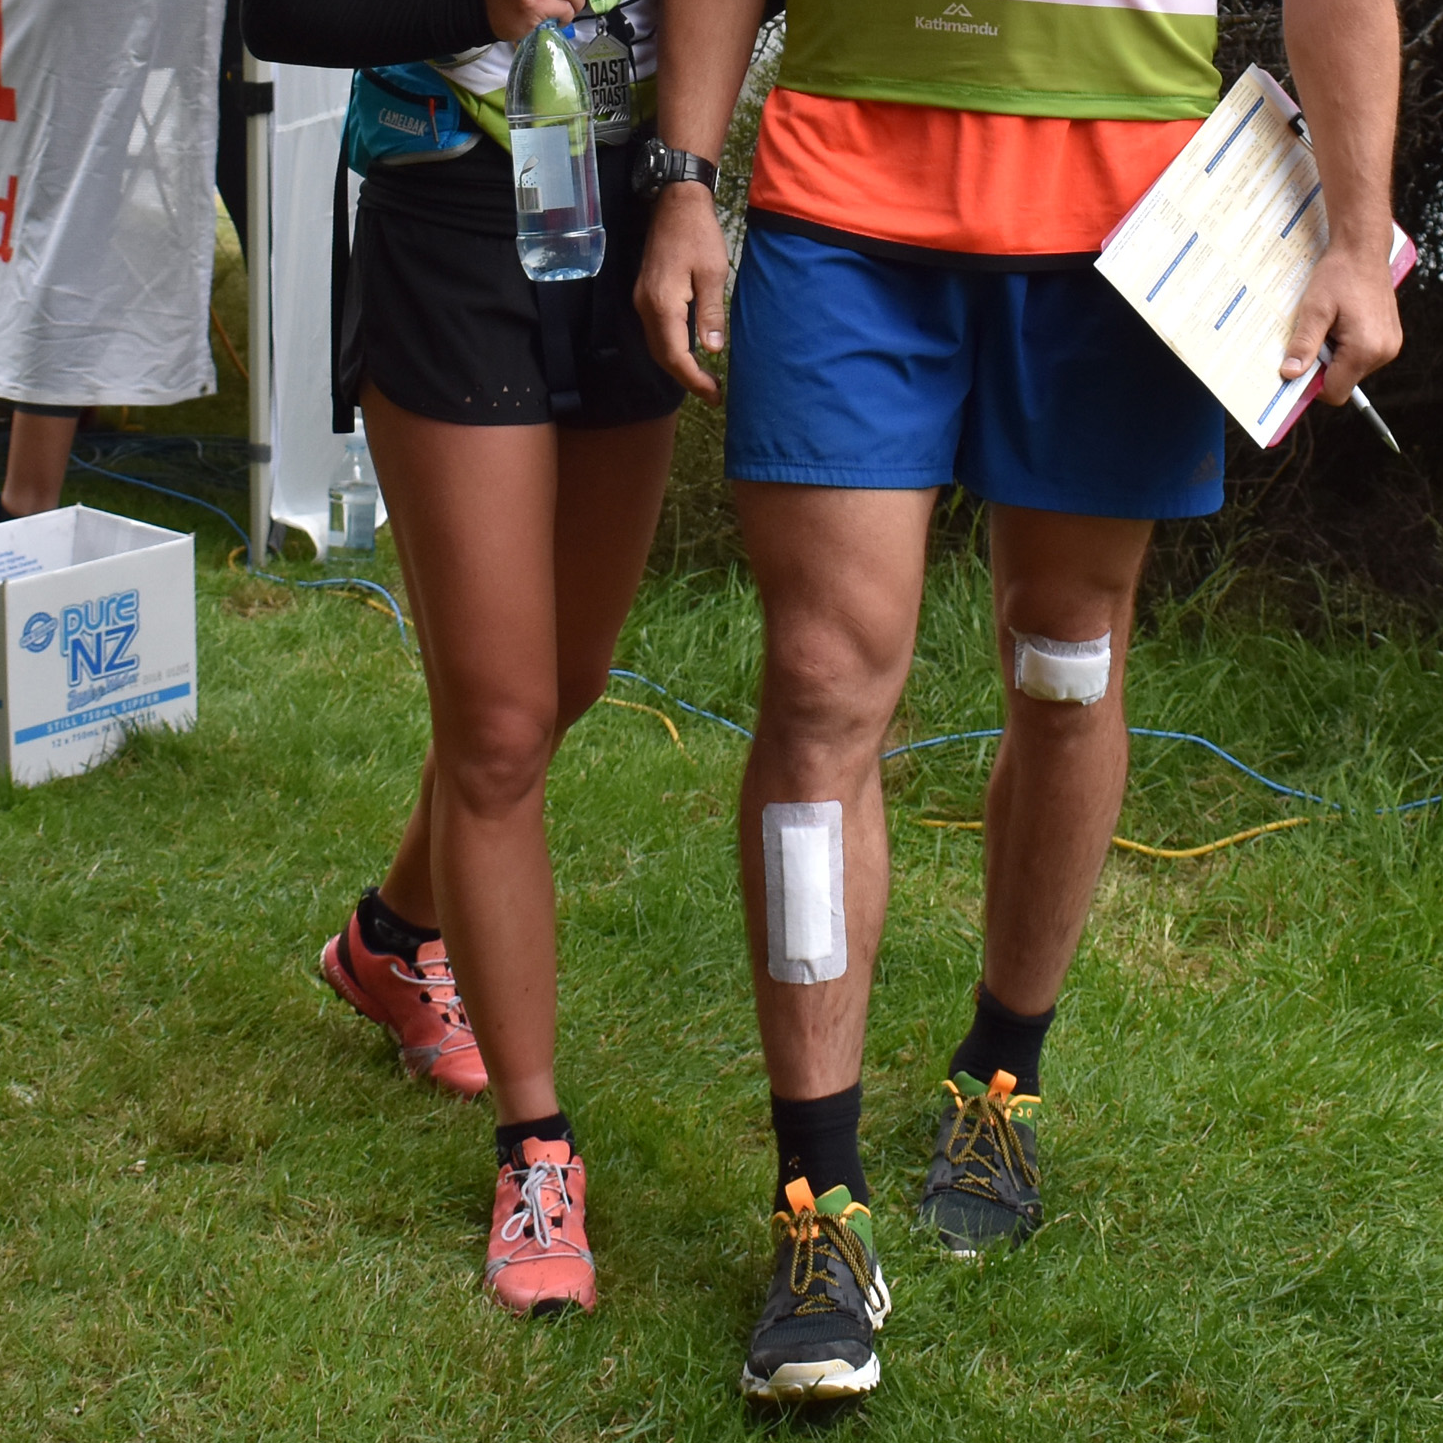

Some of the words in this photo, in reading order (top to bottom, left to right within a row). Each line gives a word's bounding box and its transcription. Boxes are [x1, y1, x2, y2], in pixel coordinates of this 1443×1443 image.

[914, 13, 999, 37] Kathmandu
[378, 107, 427, 137] CAMELBAK
[60, 590, 139, 657] pure
[67, 623, 140, 686] NZ
[46, 715, 78, 734] STILL
[81, 705, 118, 723] 750mL
[121, 693, 160, 714] SIPPER
